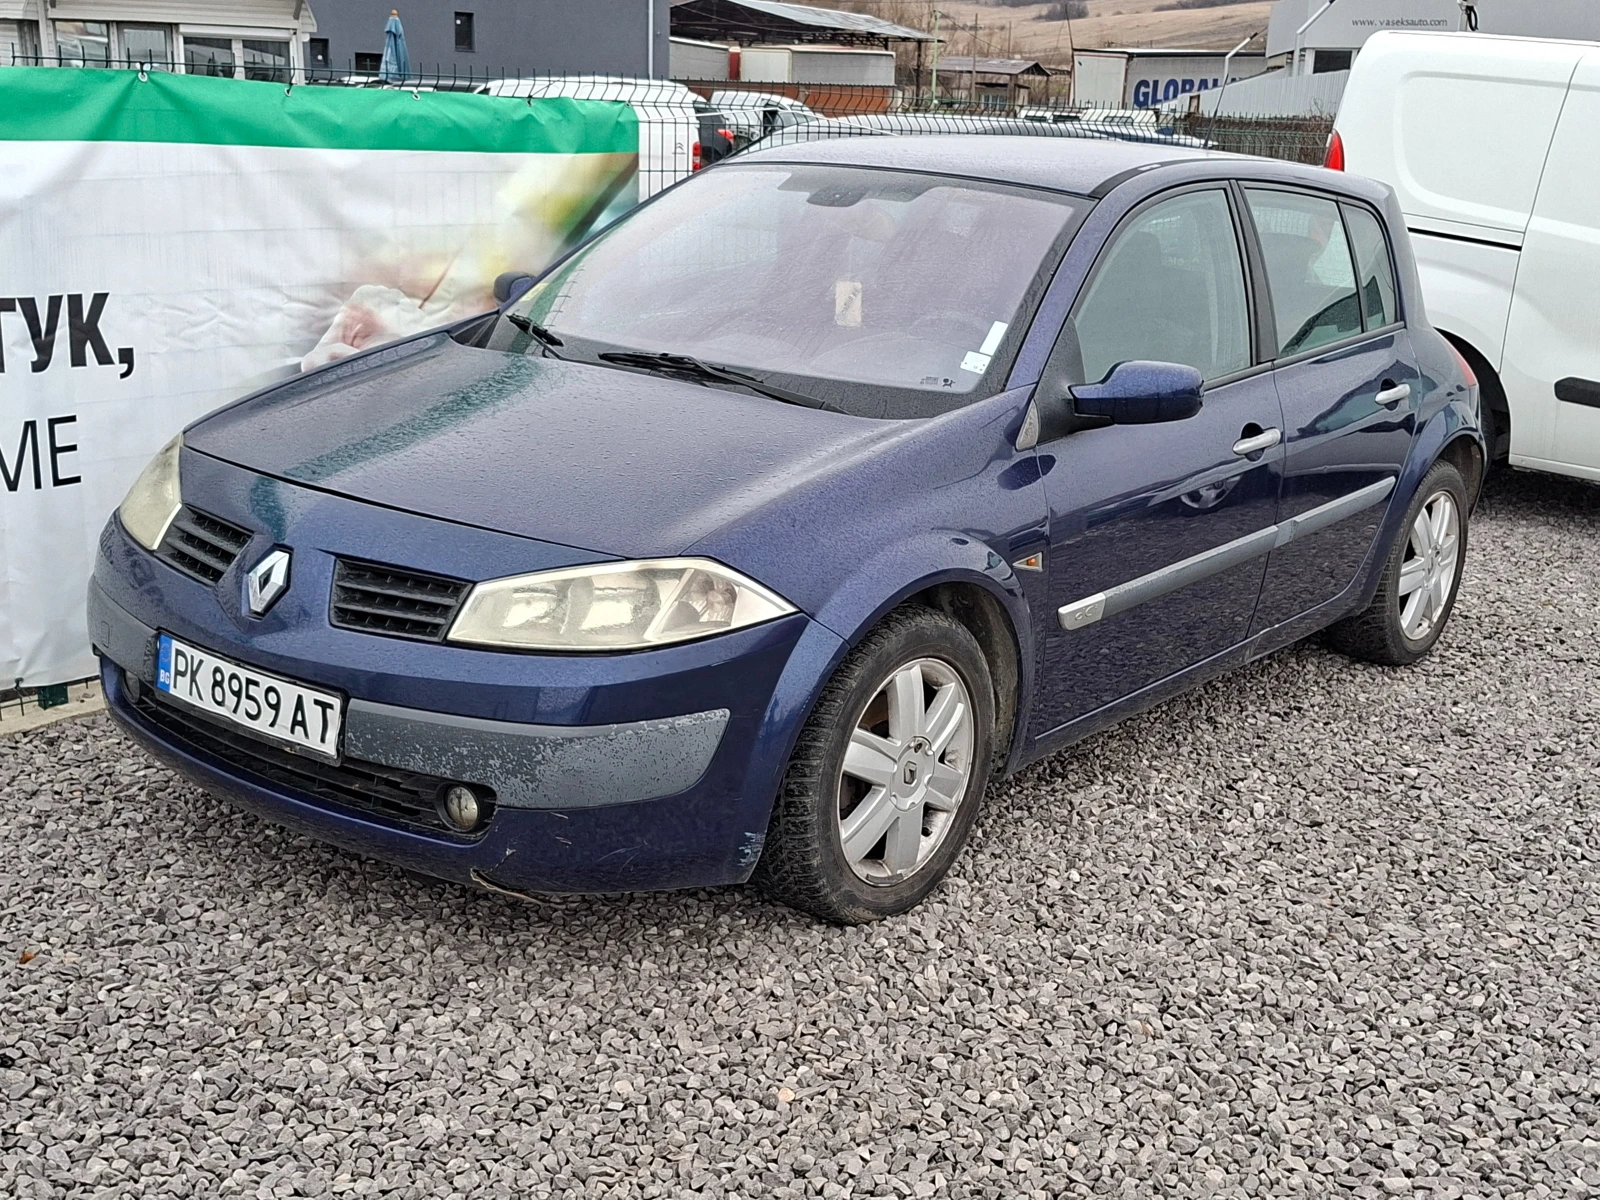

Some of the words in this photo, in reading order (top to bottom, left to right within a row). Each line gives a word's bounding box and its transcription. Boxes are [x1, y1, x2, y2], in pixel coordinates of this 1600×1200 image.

[160, 669, 170, 685] BG
[173, 648, 204, 701] PK
[211, 665, 282, 729] 8959
[290, 694, 335, 744] AT
